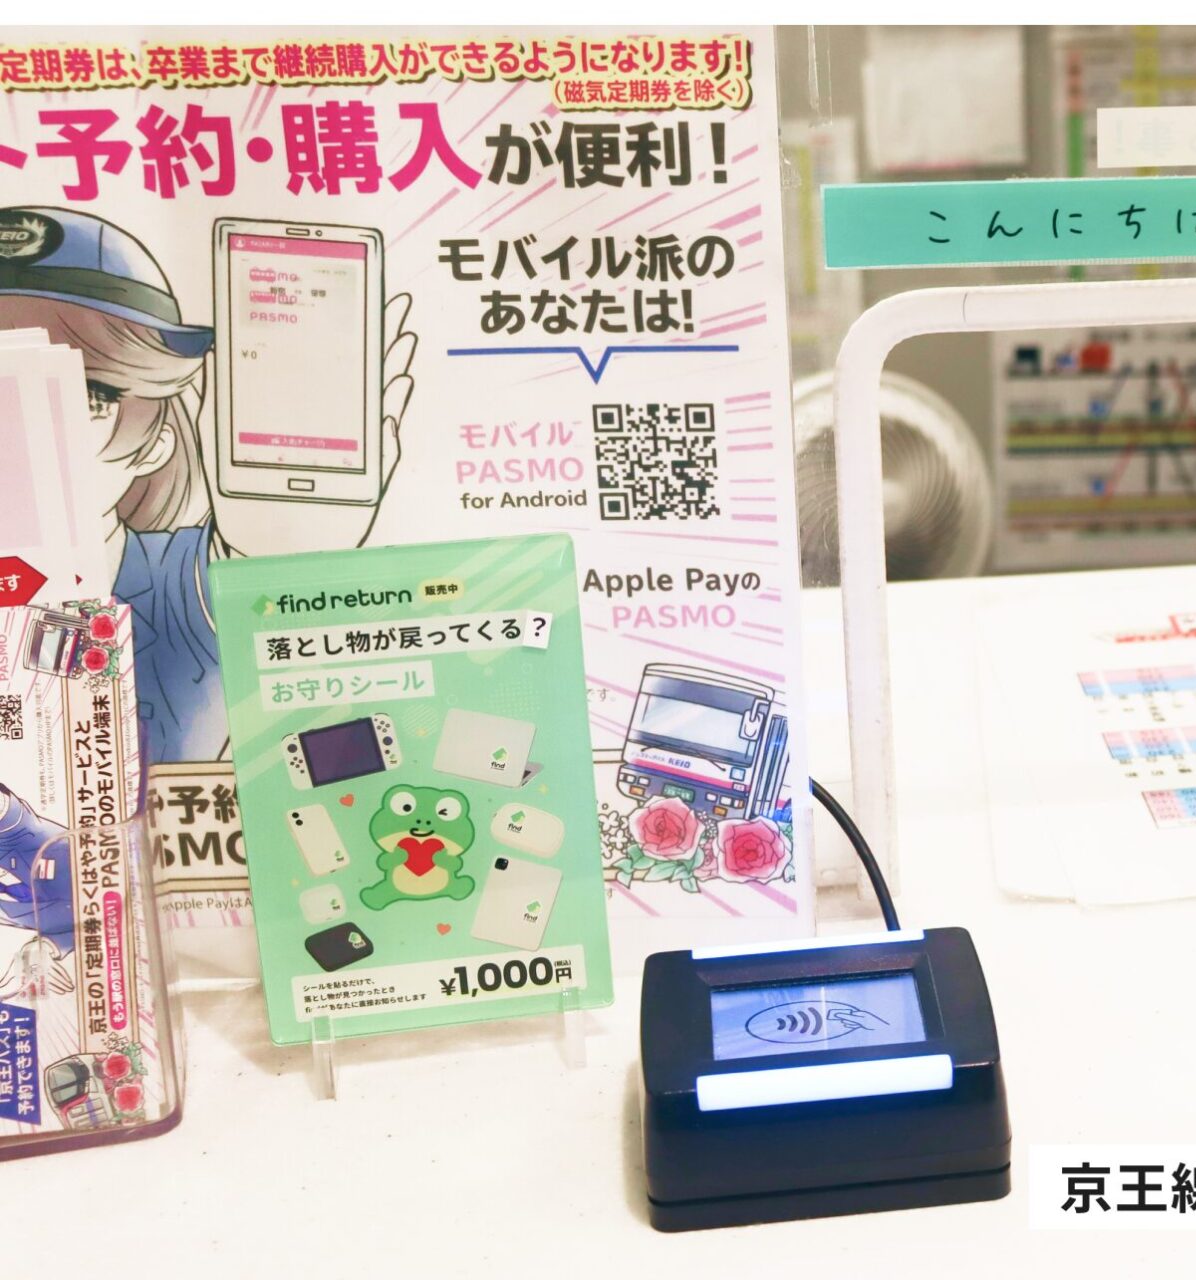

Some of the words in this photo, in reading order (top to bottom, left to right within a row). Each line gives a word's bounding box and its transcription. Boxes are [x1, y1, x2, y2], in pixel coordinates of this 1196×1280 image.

[437, 234, 736, 283] モバイル派の
[250, 310, 298, 324] PASMO
[480, 289, 695, 335] あなたは！
[459, 422, 575, 451] モバイル
[455, 456, 586, 485] PASMO
[460, 491, 493, 510] for
[498, 488, 588, 509] Android
[425, 583, 458, 596] 販売中
[583, 567, 674, 599] Apple
[686, 567, 761, 597] Payの
[277, 592, 326, 614] find
[330, 587, 412, 609] return
[612, 604, 737, 630] PASMO
[267, 617, 547, 661] 落とし物が戻ってくる？
[271, 670, 425, 704] お守りシール
[491, 761, 506, 770] find
[668, 756, 691, 769] KEIO
[507, 822, 523, 833] find
[524, 912, 538, 923] find
[107, 897, 125, 1023] もう駅の窓口に並ばない！
[303, 979, 376, 992] シールを貼るだけで、
[304, 986, 396, 1003] 落とし物が見つかったとき
[14, 1016, 35, 1115] 予約できます！
